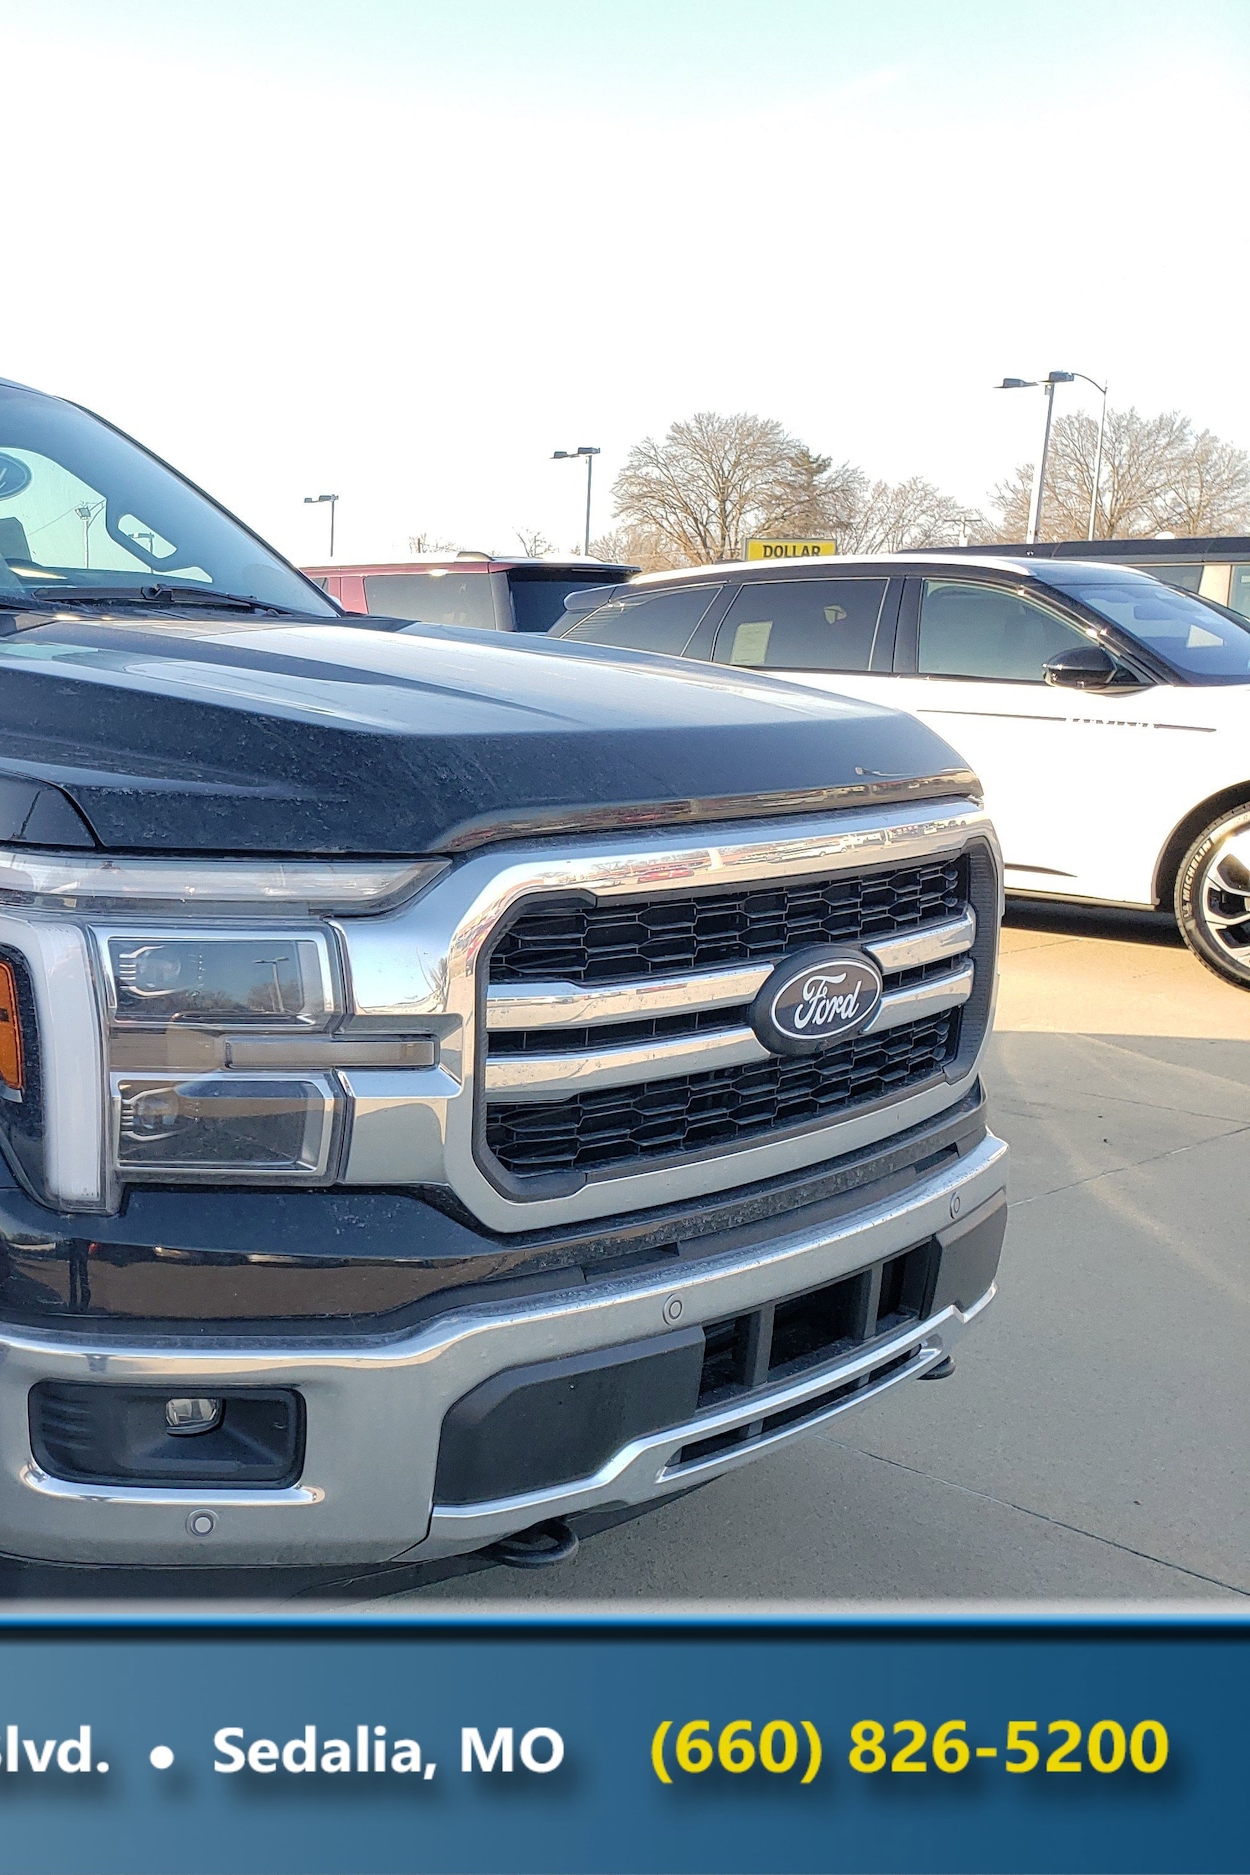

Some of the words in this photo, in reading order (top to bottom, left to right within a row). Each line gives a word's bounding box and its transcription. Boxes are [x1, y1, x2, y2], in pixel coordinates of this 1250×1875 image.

[763, 544, 821, 558] DOLLAR
[1183, 838, 1213, 902] MICHELIN
[794, 972, 862, 1029] Ford
